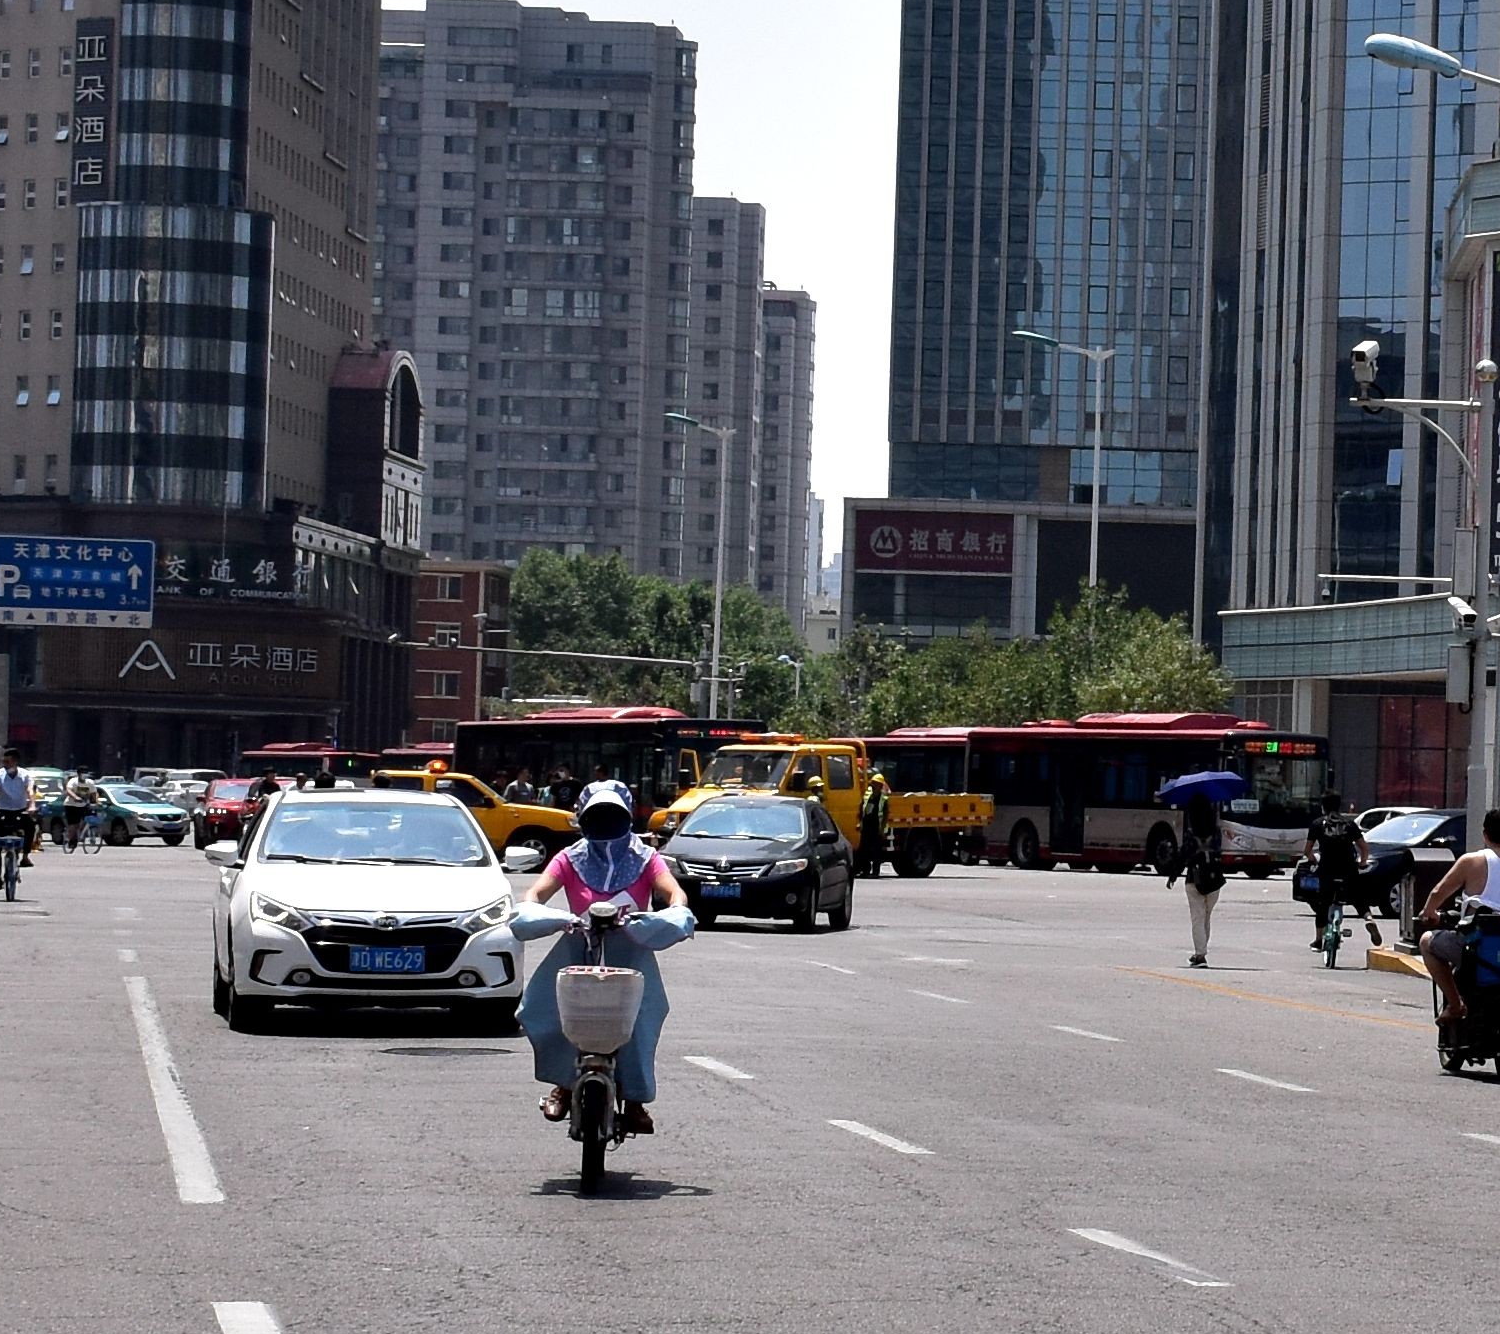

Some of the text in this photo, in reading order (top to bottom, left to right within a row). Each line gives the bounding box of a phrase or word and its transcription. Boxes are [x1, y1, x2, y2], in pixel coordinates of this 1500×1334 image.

[73, 35, 108, 186] 亚朵酒店
[13, 542, 134, 563] 天津文化中心
[156, 585, 182, 595] ANK
[200, 587, 214, 597] OF
[186, 642, 319, 673] 亚朵酒店
